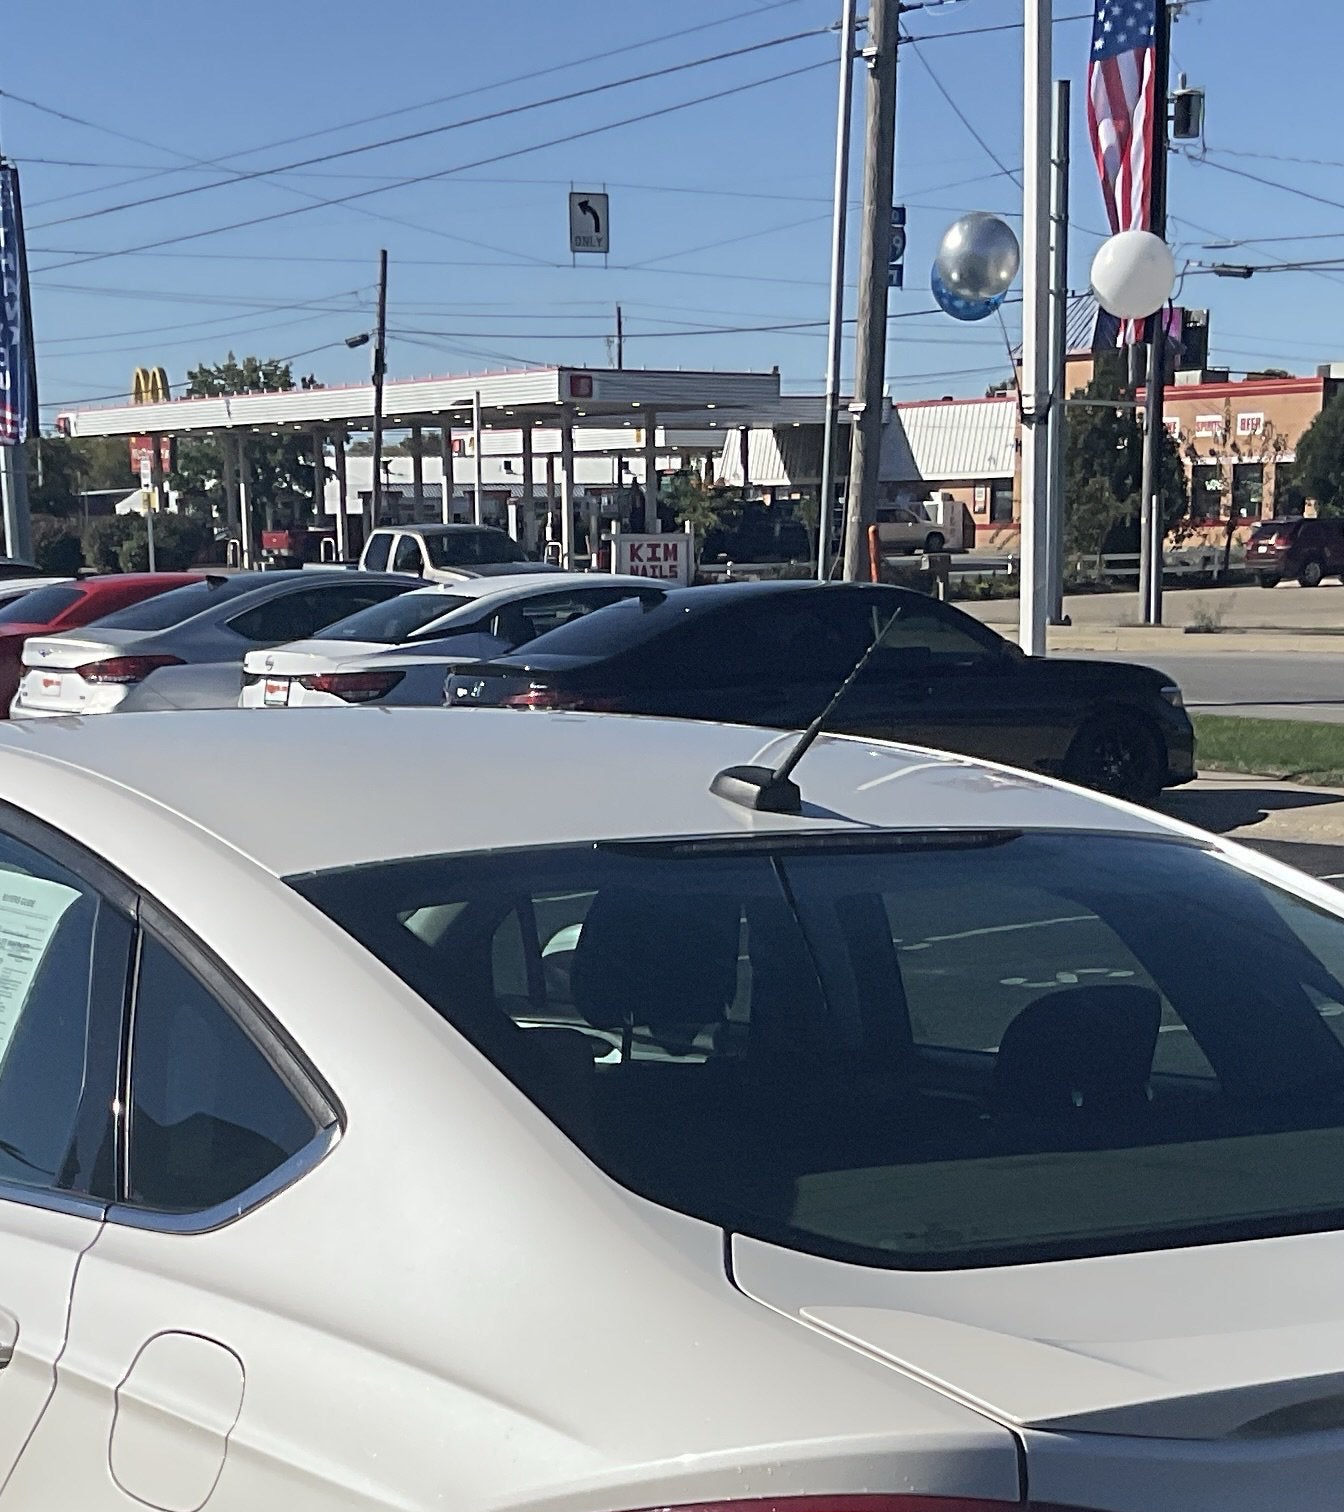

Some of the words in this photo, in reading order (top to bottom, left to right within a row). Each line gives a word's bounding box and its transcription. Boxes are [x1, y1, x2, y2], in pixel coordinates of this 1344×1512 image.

[574, 235, 603, 247] ONLY
[629, 542, 678, 562] KIM
[629, 564, 678, 579] NAILS
